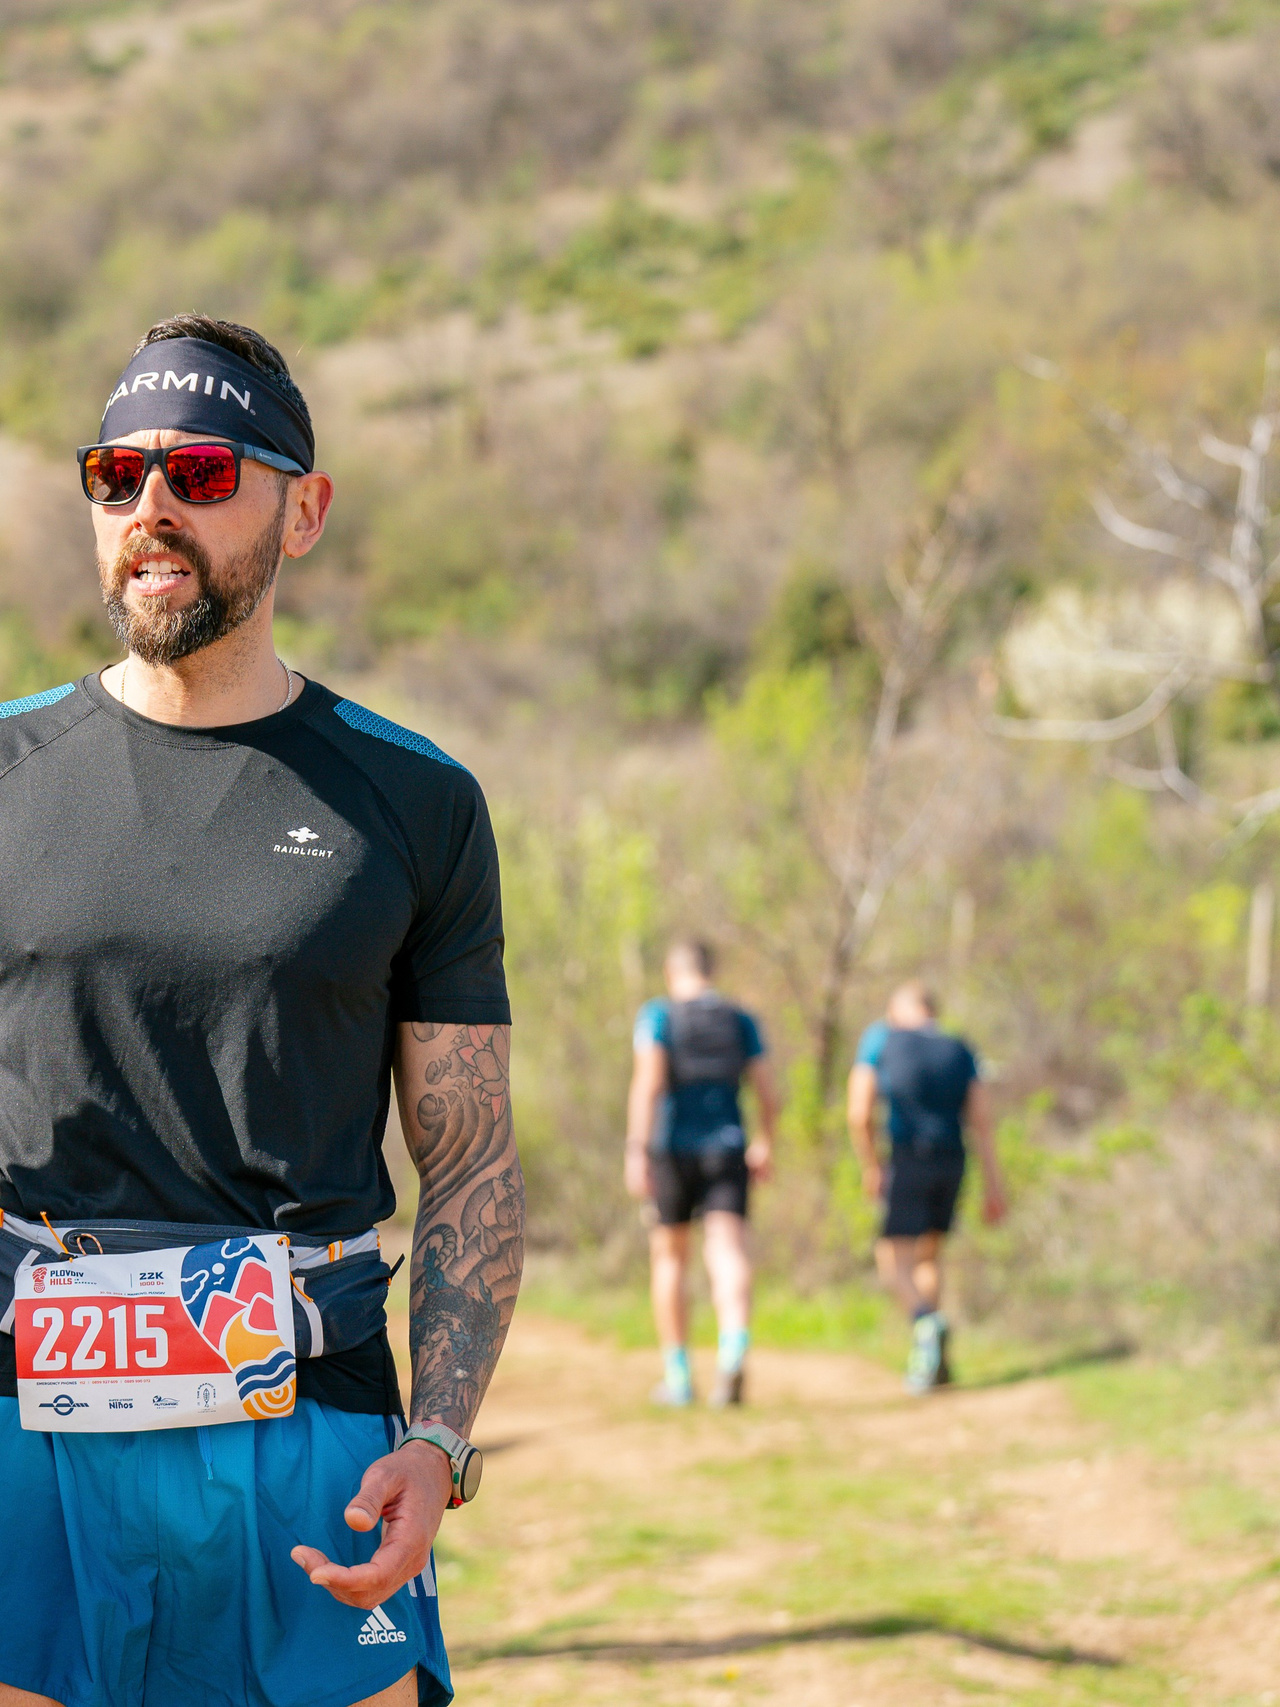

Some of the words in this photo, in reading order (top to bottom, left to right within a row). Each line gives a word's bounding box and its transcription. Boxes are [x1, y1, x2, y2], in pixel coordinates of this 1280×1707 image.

[102, 370, 251, 421] ARMIN
[273, 844, 334, 858] RAIDLIGHT
[50, 1269, 85, 1278] PLOVDIV
[139, 1271, 165, 1281] 22K
[50, 1277, 73, 1286] HILLS
[32, 1304, 169, 1372] 2215
[357, 1628, 407, 1646] adidas
